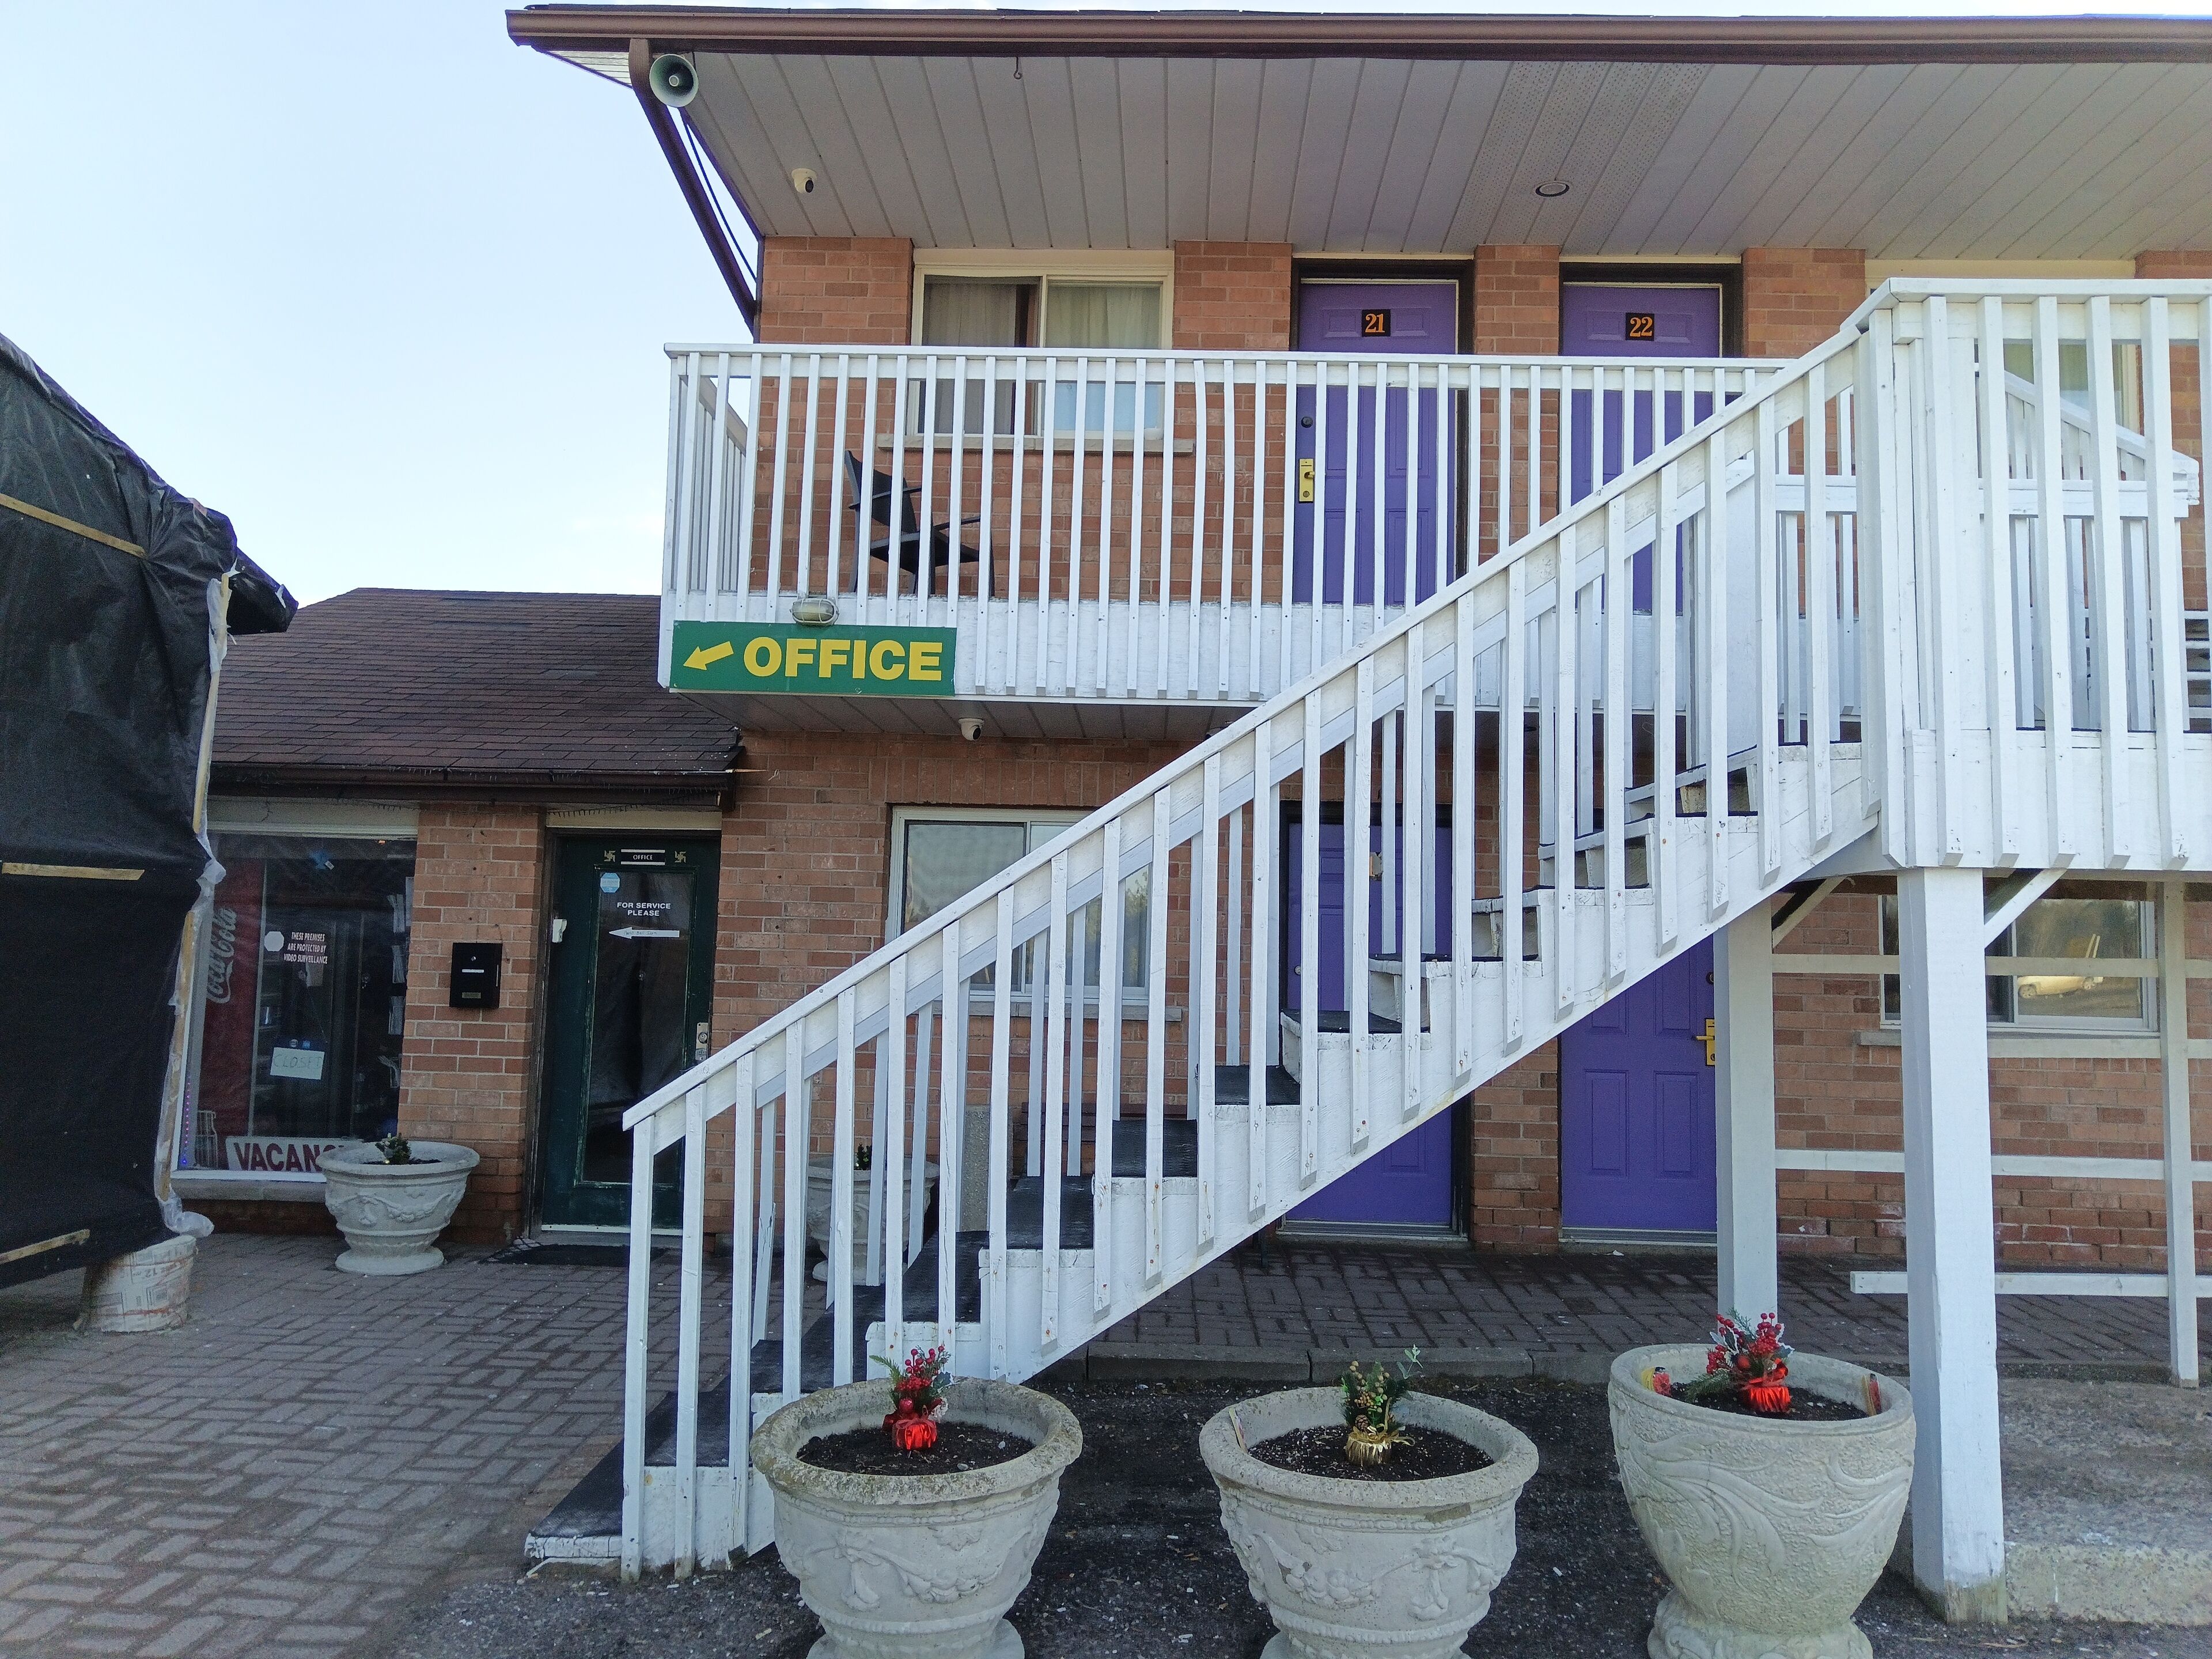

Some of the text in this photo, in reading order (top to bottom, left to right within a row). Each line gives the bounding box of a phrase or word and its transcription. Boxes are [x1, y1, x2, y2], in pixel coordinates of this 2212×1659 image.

[1365, 313, 1385, 332] 21
[1630, 316, 1653, 337] 22
[744, 637, 942, 680] OFFICE
[291, 932, 325, 942] THESE PREMISES
[297, 944, 320, 952] PROTECTED
[320, 945, 327, 953] BY
[283, 953, 328, 964] VIDEO SURVEILLANCE
[274, 1054, 324, 1069] CLOSED
[233, 1143, 344, 1172] VACAN
